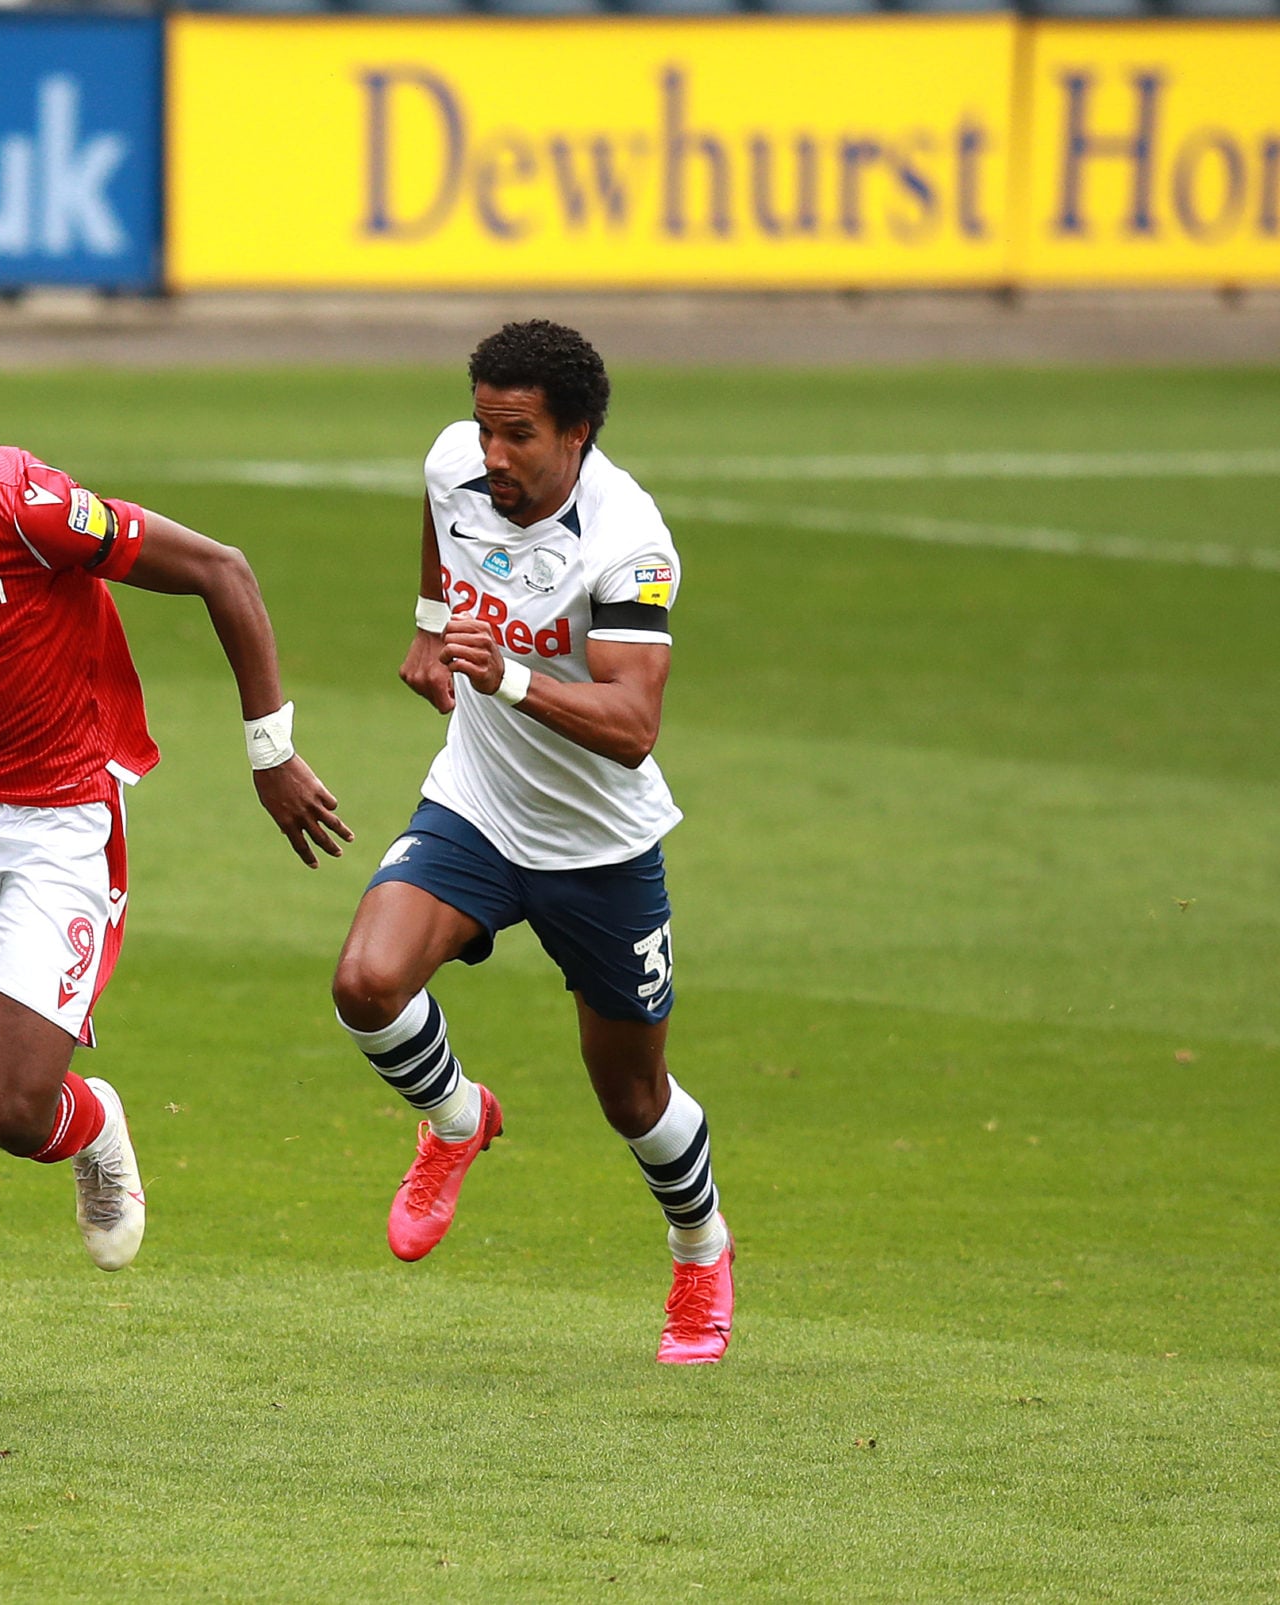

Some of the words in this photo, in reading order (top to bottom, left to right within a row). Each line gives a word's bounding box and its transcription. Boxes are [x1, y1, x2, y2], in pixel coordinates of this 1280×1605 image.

[352, 60, 990, 244] Dewhurst
[636, 570, 656, 582] sky
[656, 568, 672, 580] bet
[65, 917, 95, 981] 9
